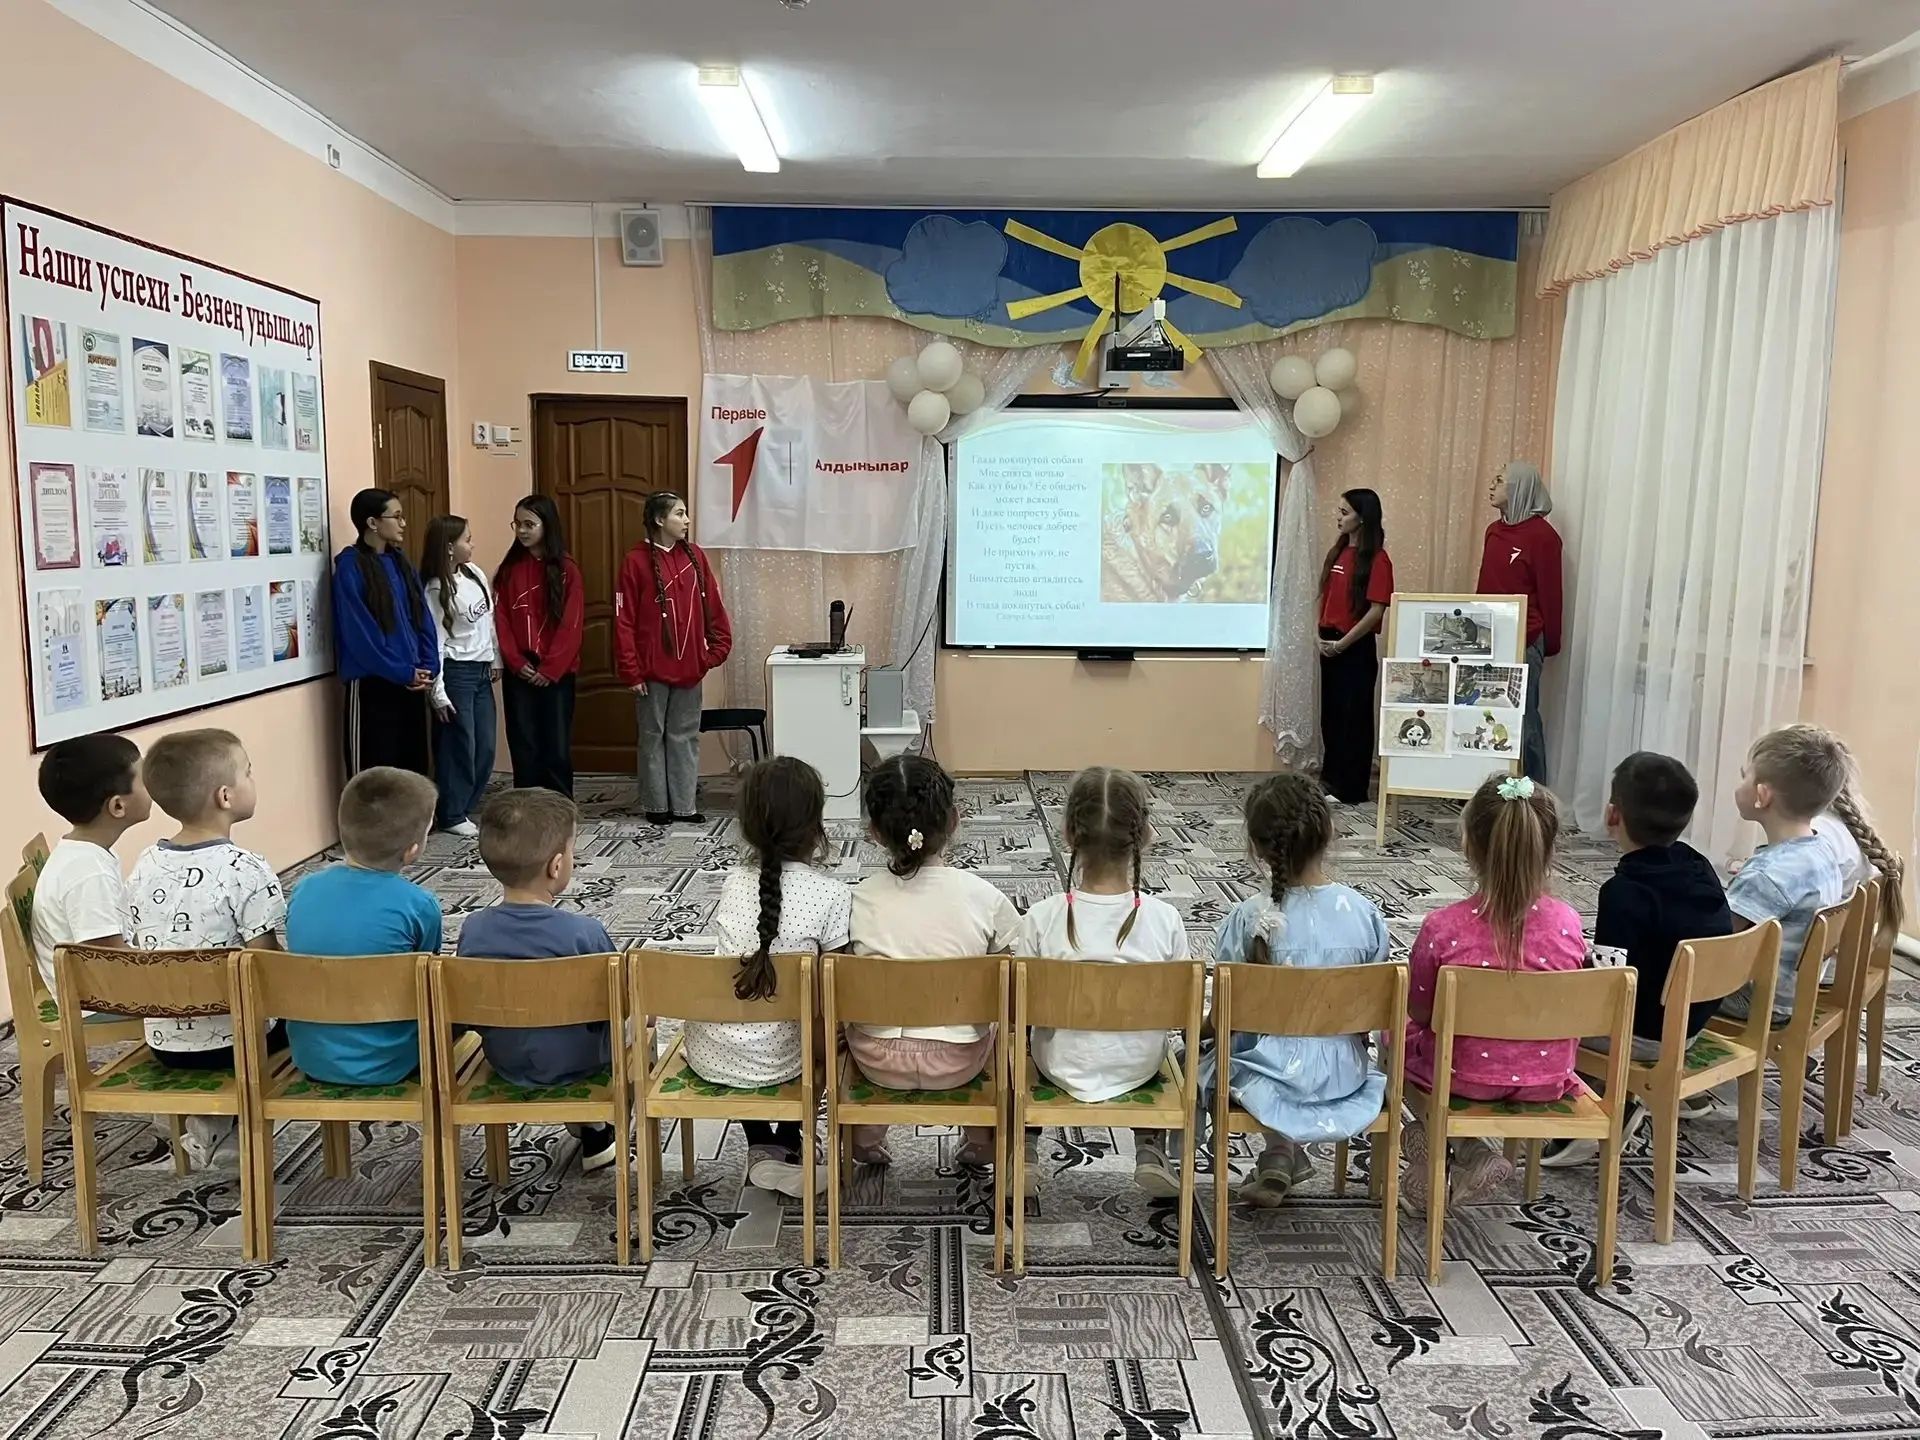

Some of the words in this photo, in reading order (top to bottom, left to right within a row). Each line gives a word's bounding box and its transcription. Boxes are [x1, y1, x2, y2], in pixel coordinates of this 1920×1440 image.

[17, 222, 92, 292] Наши
[96, 261, 171, 311] успехи
[573, 355, 623, 369] ВЫХОД
[711, 406, 767, 424] Первые
[184, 867, 204, 888] D
